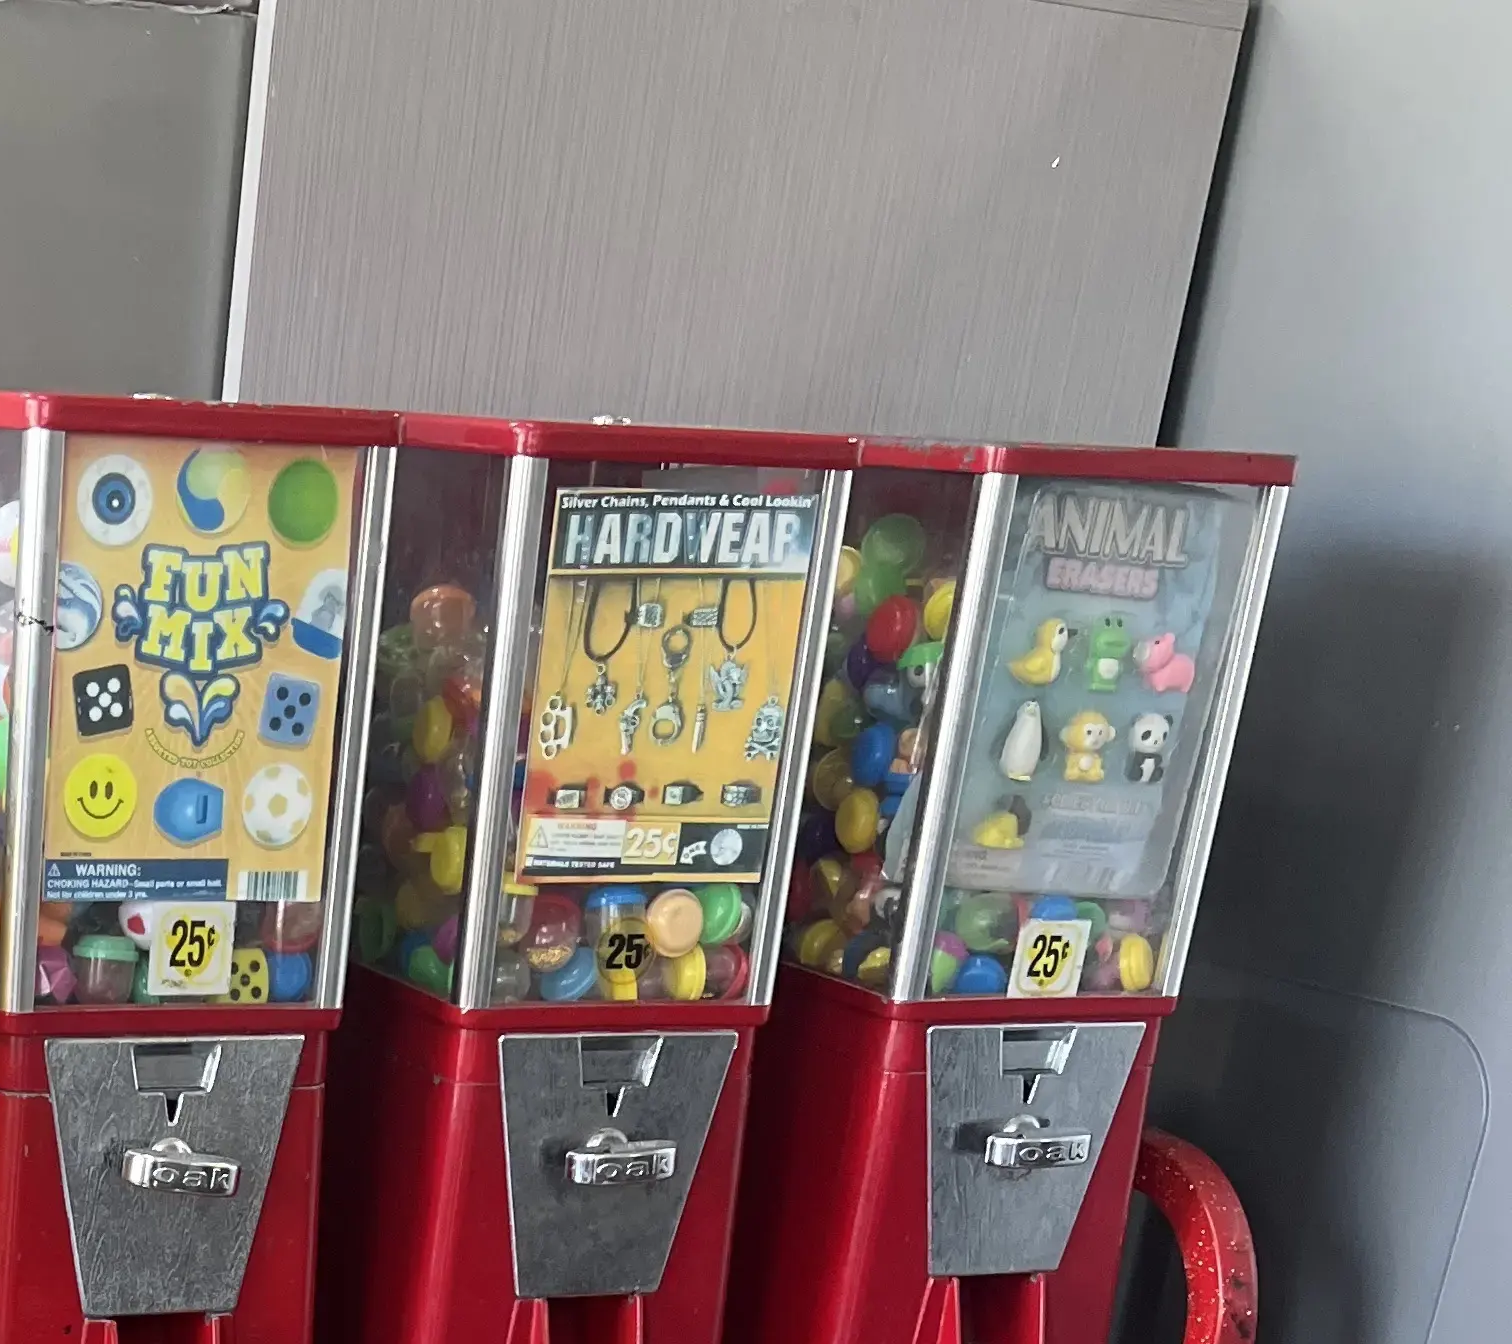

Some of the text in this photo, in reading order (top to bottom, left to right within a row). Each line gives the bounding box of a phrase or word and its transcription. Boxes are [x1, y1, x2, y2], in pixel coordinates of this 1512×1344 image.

[561, 495, 598, 509] Silver
[601, 494, 649, 509] Chains,
[653, 493, 716, 508] Pendants
[719, 494, 729, 507] &
[733, 493, 763, 507] Cool
[1029, 492, 1188, 567] ANIMAL
[144, 547, 268, 611] FUN
[1046, 557, 1160, 600] ERASERS
[141, 610, 261, 672] MIX
[624, 826, 679, 860] 25¢
[47, 879, 90, 889] CHOKING
[75, 863, 142, 877] WARNING:
[169, 919, 216, 968] 25¢
[1026, 934, 1070, 978] 25¢
[1018, 1141, 1085, 1161] oak
[152, 1161, 233, 1190] oak
